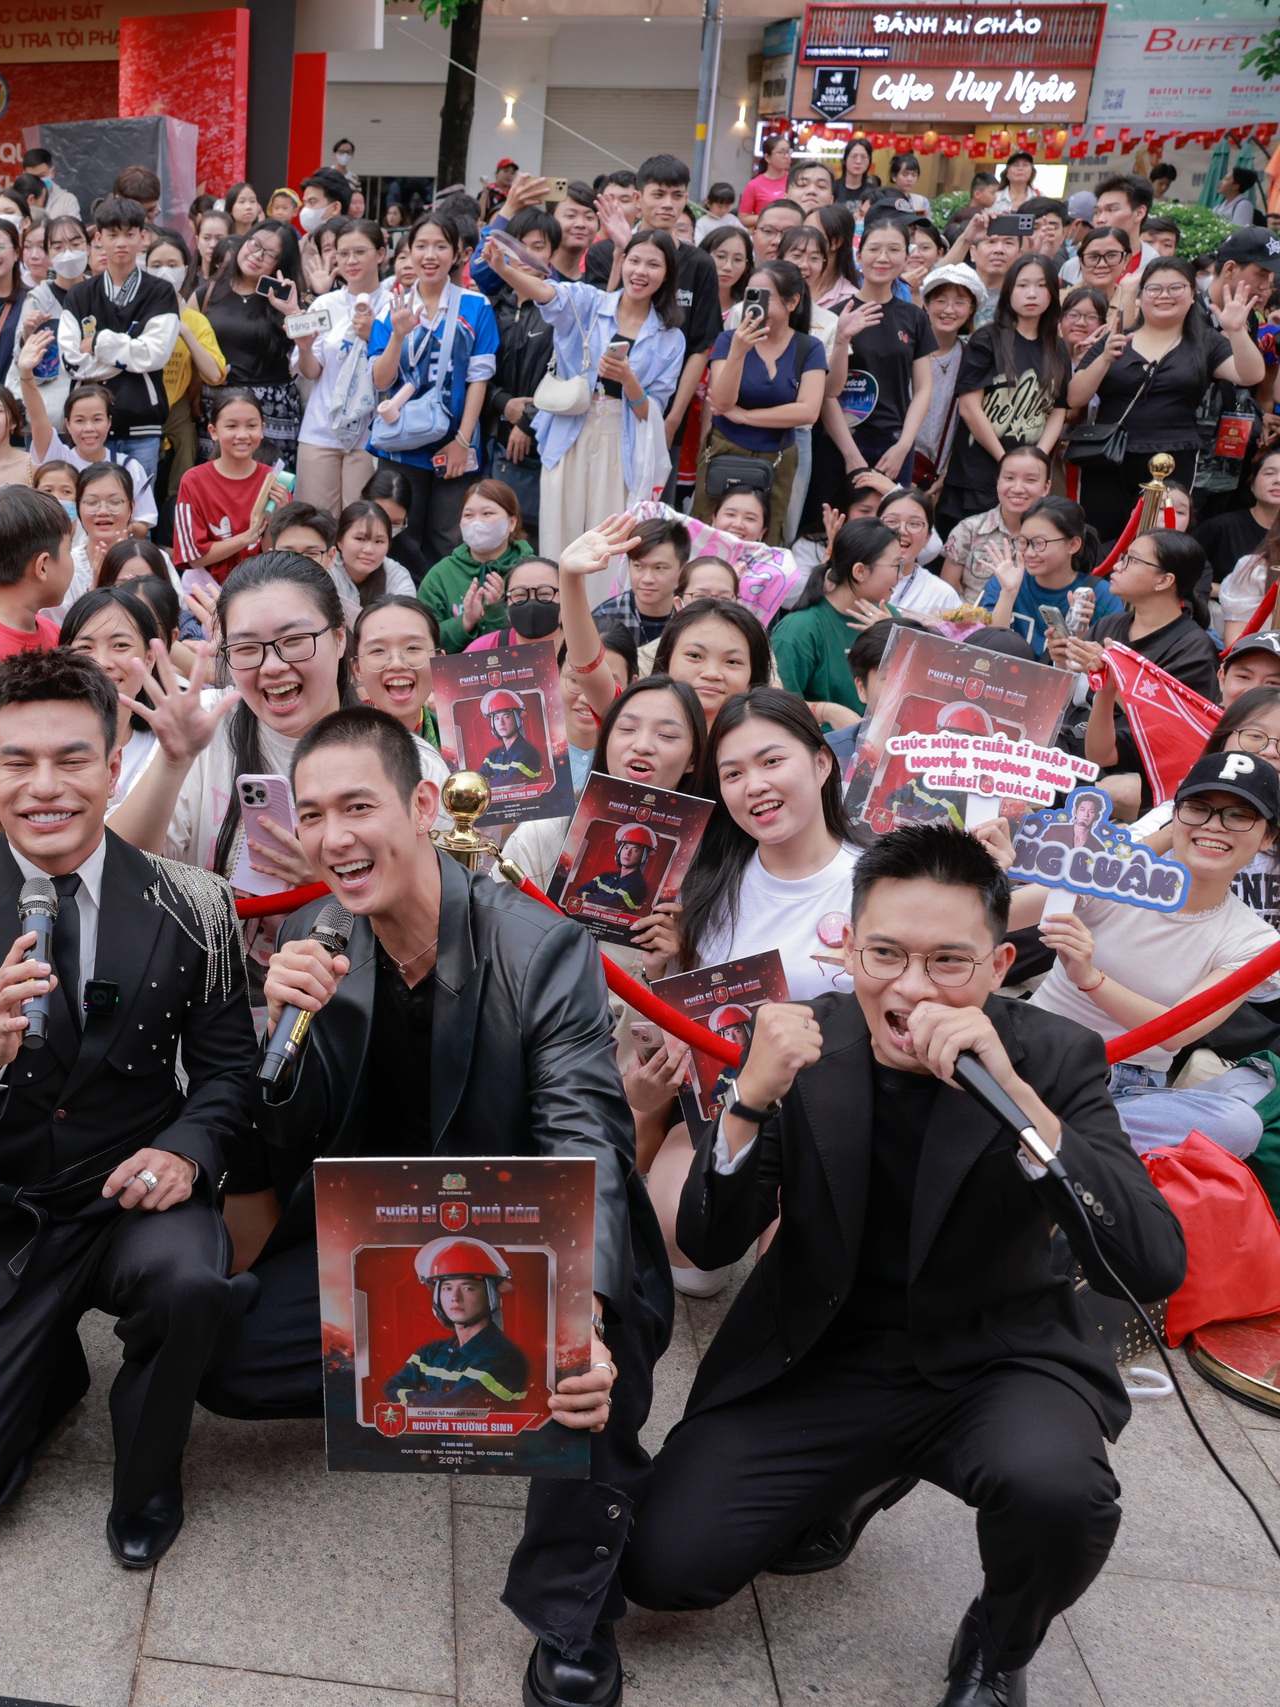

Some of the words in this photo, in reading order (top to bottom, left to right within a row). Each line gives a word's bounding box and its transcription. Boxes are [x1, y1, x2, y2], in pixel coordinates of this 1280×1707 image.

[16, 2, 67, 24] CẢNH
[71, 2, 103, 21] SÁT
[873, 11, 937, 35] BÁNH
[974, 9, 1041, 35] CHẢO
[20, 30, 52, 48] TRA
[58, 30, 84, 49] TỘI
[825, 86, 845, 95] HUY
[872, 73, 934, 110] Coffee
[945, 70, 1003, 112] Huy
[1004, 71, 1077, 114] Ngân
[890, 733, 928, 752] CHÚC
[931, 732, 970, 751] MỪNG
[972, 736, 1013, 756] CHIẾN
[1015, 742, 1030, 759] SĨ
[1031, 747, 1068, 769] NHẬP
[1070, 758, 1095, 778] VAI
[1219, 753, 1255, 781] P
[910, 751, 967, 770] NGUYỄN
[972, 757, 1031, 778] TRƯỜNG
[1035, 767, 1071, 789] SINH
[1069, 851, 1182, 902] LUÂN
[376, 1204, 418, 1223] CHIẾN
[422, 1204, 437, 1223] SĨ
[471, 1203, 501, 1225] QUẢ
[504, 1203, 540, 1223] CẢM
[412, 1419, 449, 1431] NGUYỄN
[451, 1421, 488, 1432] TRƯỜNG
[490, 1423, 513, 1432] SINH
